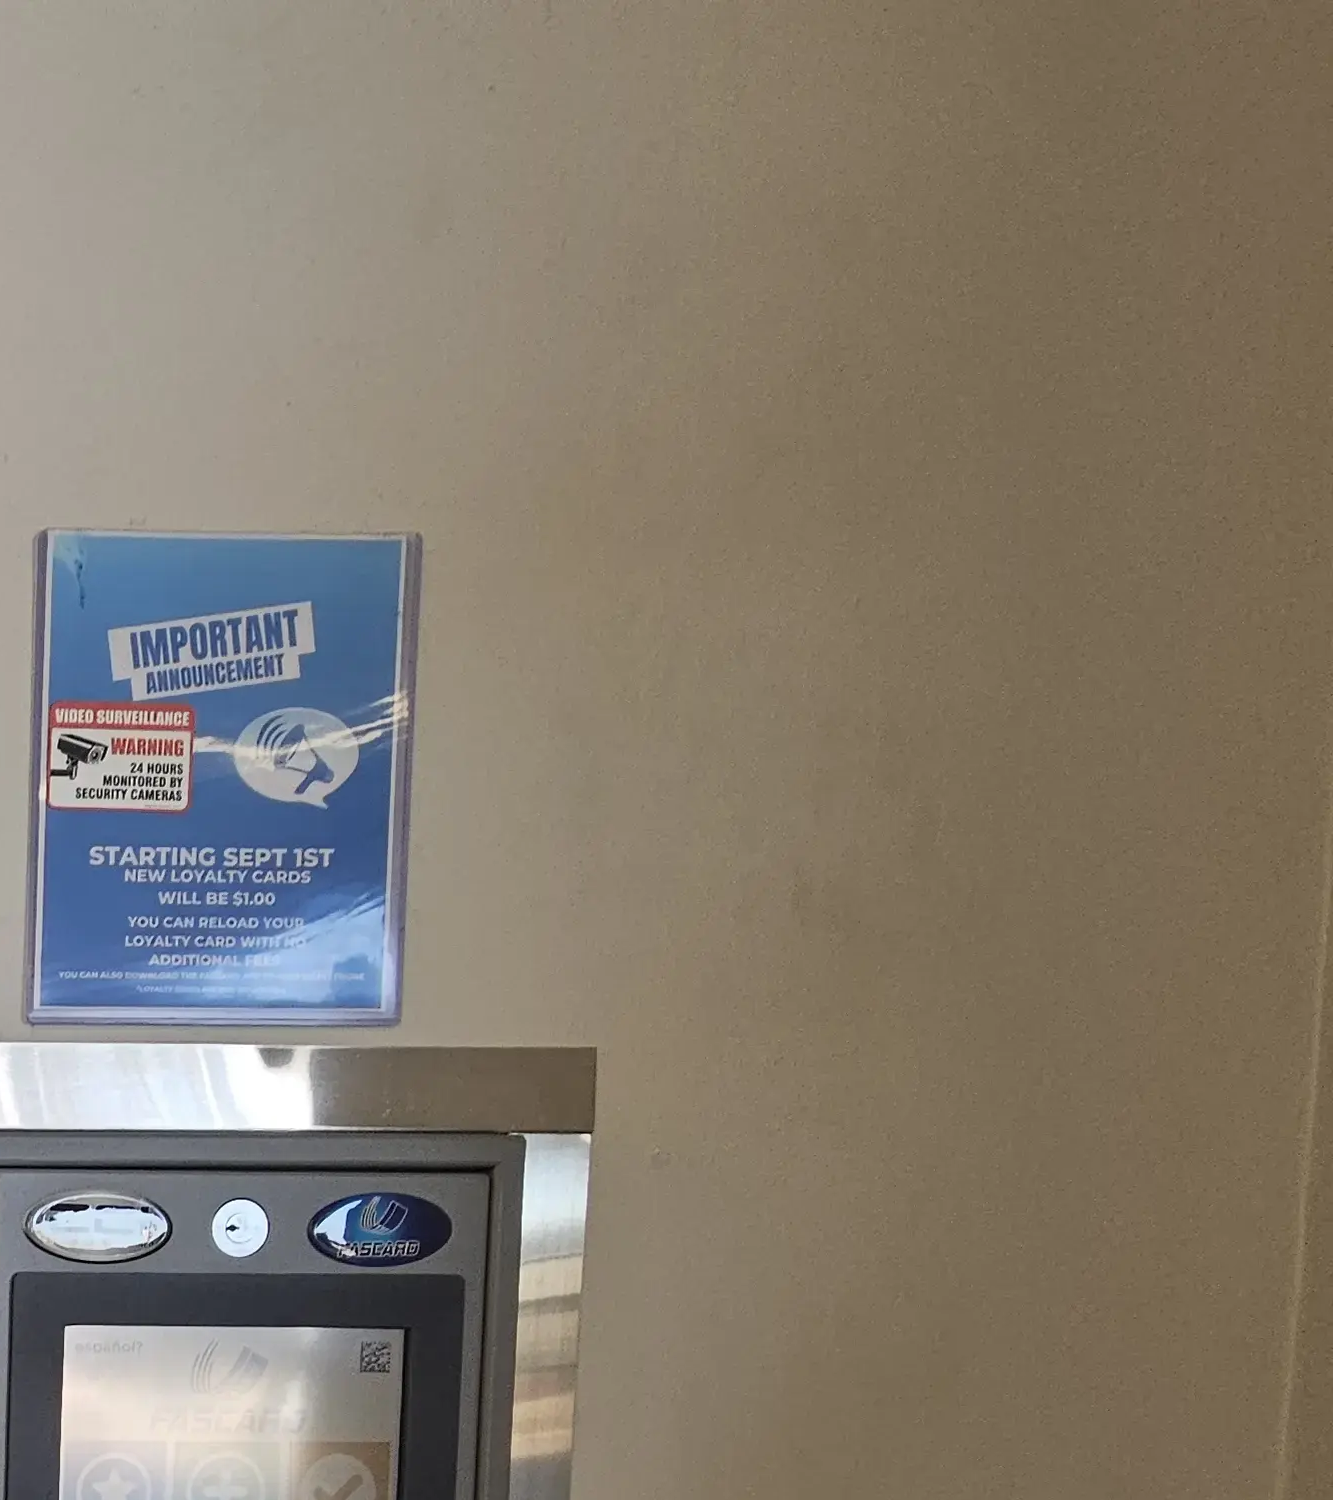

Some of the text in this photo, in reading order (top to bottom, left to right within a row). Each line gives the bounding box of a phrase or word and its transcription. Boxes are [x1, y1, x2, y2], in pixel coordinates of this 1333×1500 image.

[130, 609, 299, 669] IMPORTANT
[146, 653, 284, 694] ANNOUNCEMENT
[54, 707, 189, 726] VIDEO SURVEILLANCE
[110, 737, 184, 757] WARNING
[130, 762, 183, 775] 24 HOURS
[102, 774, 183, 788] MONITORED BY
[75, 787, 182, 802] SECURITY CAMERAS
[89, 845, 335, 867] STARTING SEPT 1ST
[124, 868, 311, 884] NEW LOYALTY CARDS
[157, 890, 276, 906] WILL BE $1.00
